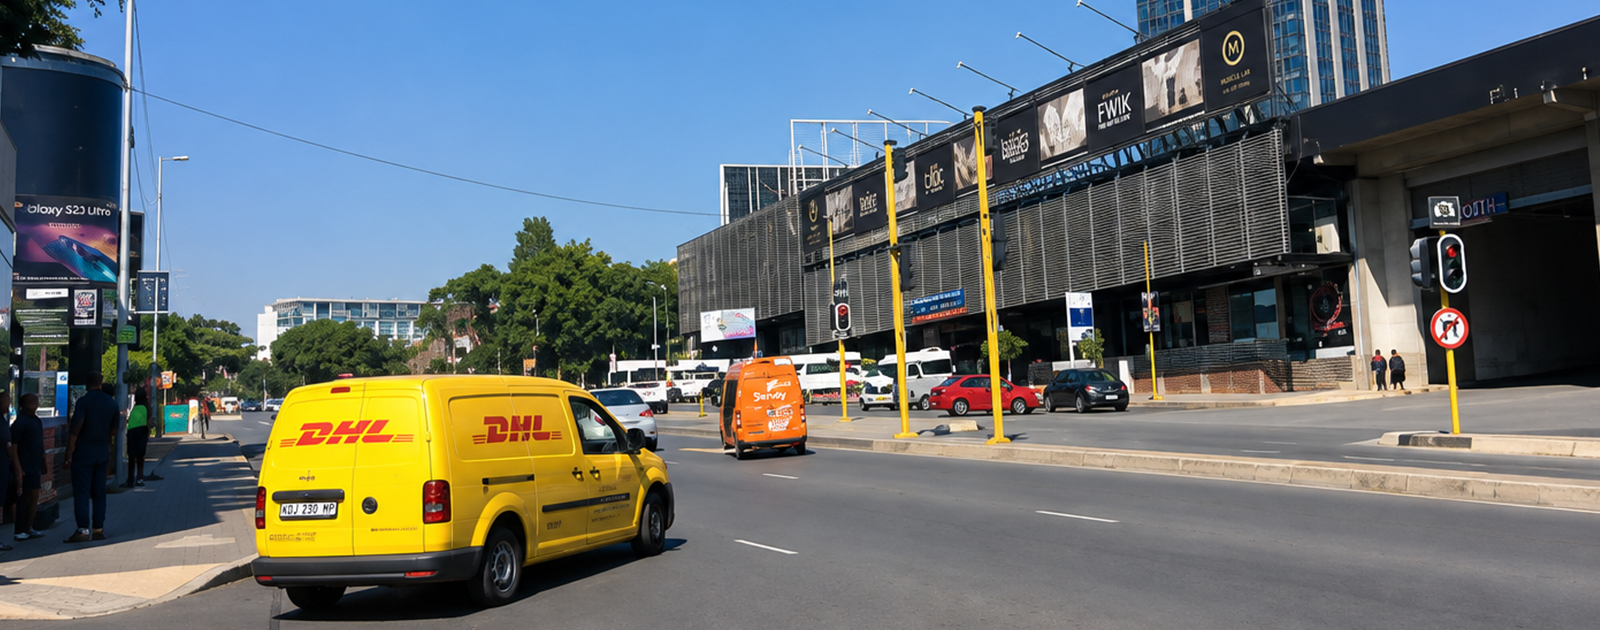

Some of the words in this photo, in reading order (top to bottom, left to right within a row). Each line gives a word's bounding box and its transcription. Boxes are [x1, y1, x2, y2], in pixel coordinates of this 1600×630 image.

[1227, 40, 1239, 57] M
[1097, 91, 1132, 123] FWIK
[296, 419, 394, 446] DHL
[483, 415, 551, 443] DHL
[302, 504, 318, 515] 230
